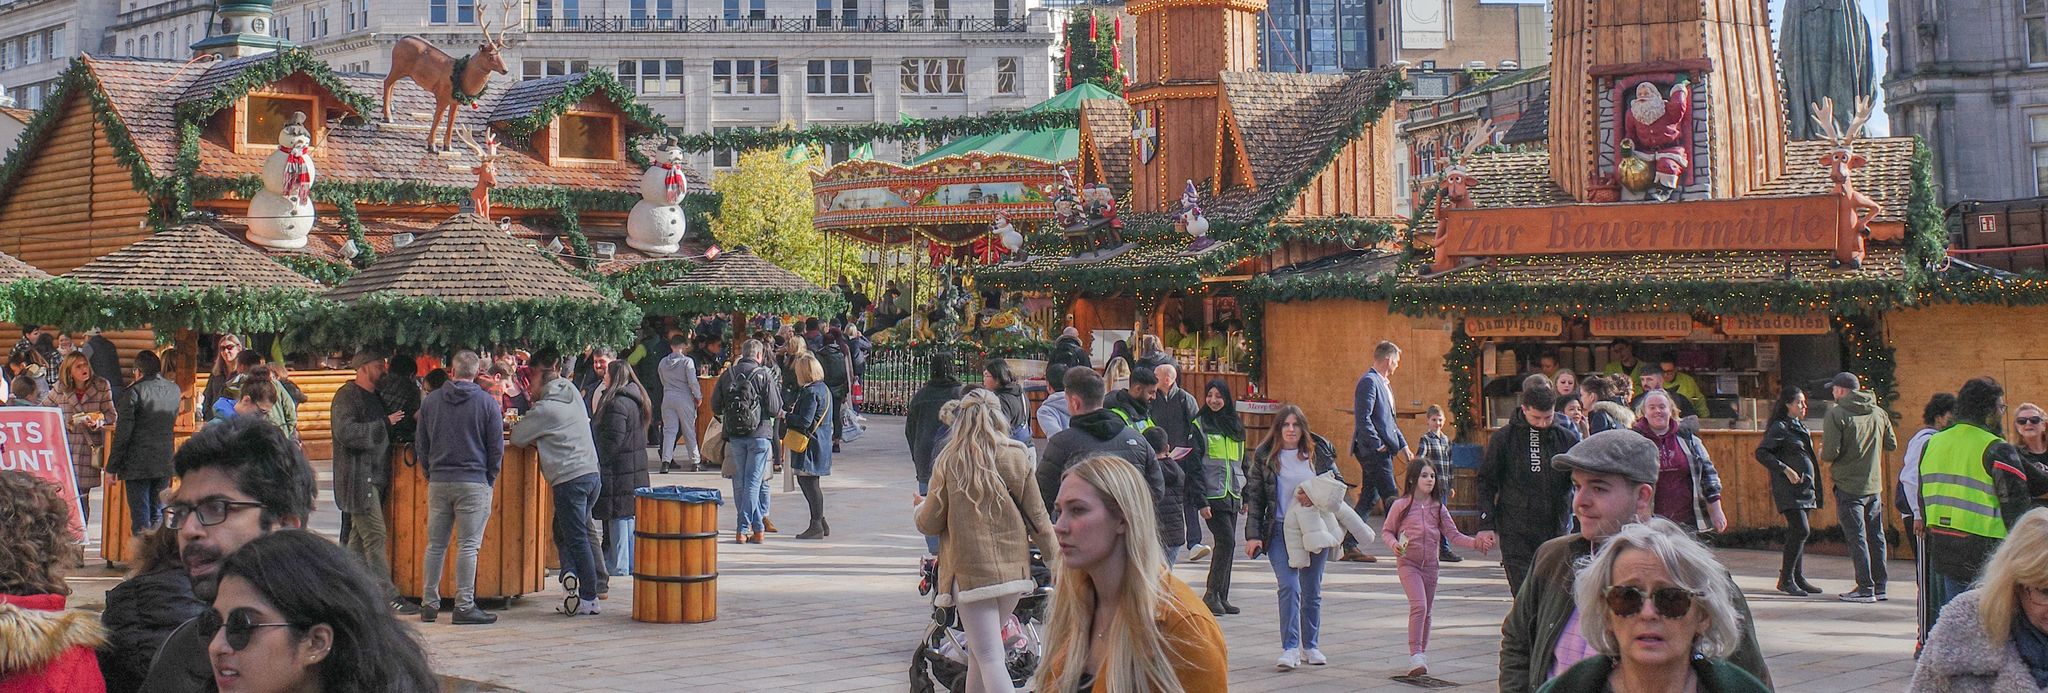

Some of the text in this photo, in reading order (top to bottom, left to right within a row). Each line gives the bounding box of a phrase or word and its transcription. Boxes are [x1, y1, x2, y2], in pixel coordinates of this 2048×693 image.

[1458, 205, 1826, 251] Zur Bauernmühle
[1467, 316, 1559, 333] Champignons
[1594, 316, 1688, 331] Bratkartoffeln
[1727, 316, 1824, 330] Frikadellen
